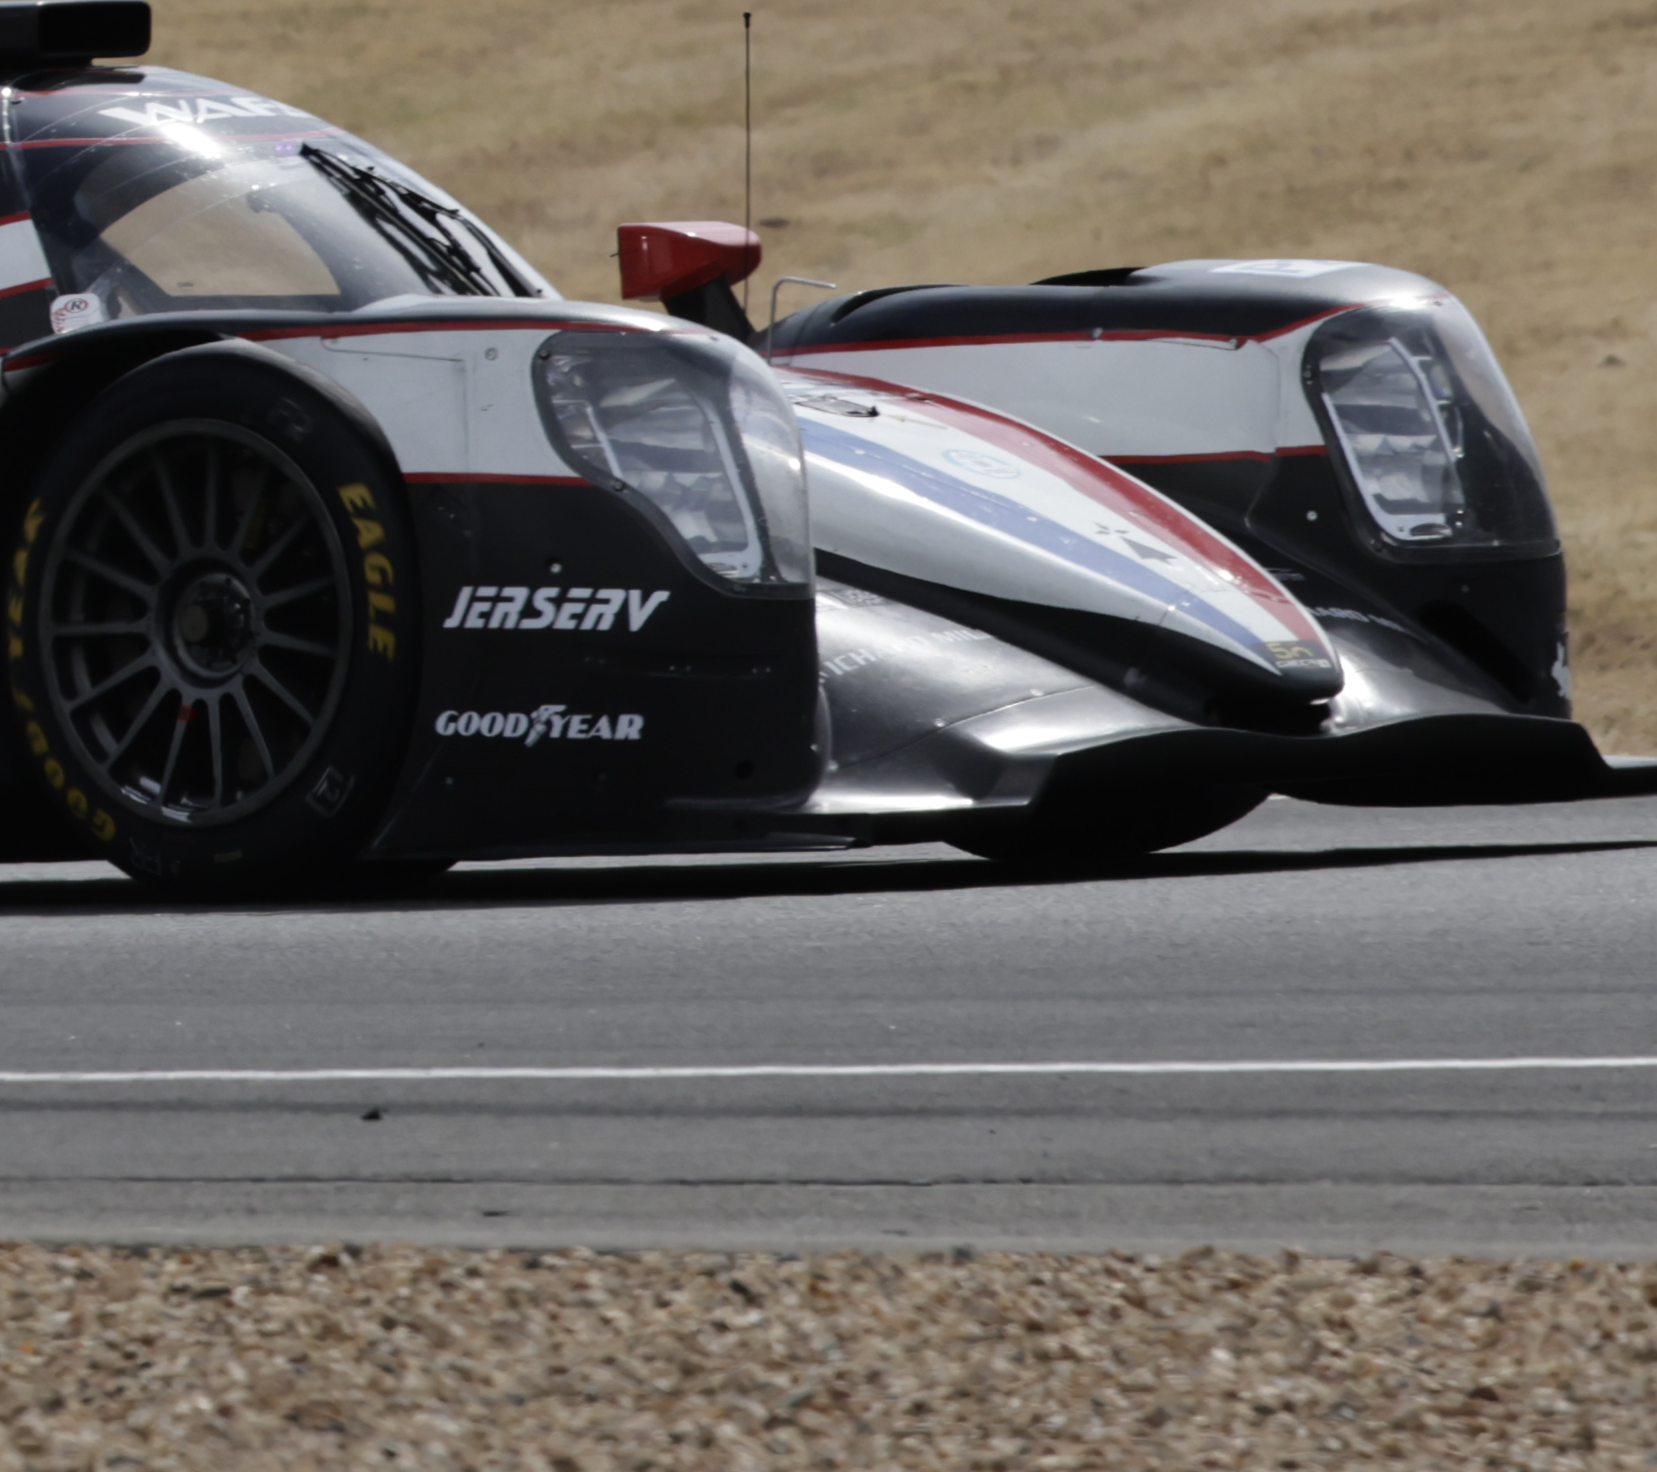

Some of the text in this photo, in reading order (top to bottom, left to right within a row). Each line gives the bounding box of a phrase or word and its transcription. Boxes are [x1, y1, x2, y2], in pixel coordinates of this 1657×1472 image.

[337, 483, 397, 659] EAGLE
[443, 586, 671, 632] JERSERV
[435, 704, 644, 747] GOODYEAR
